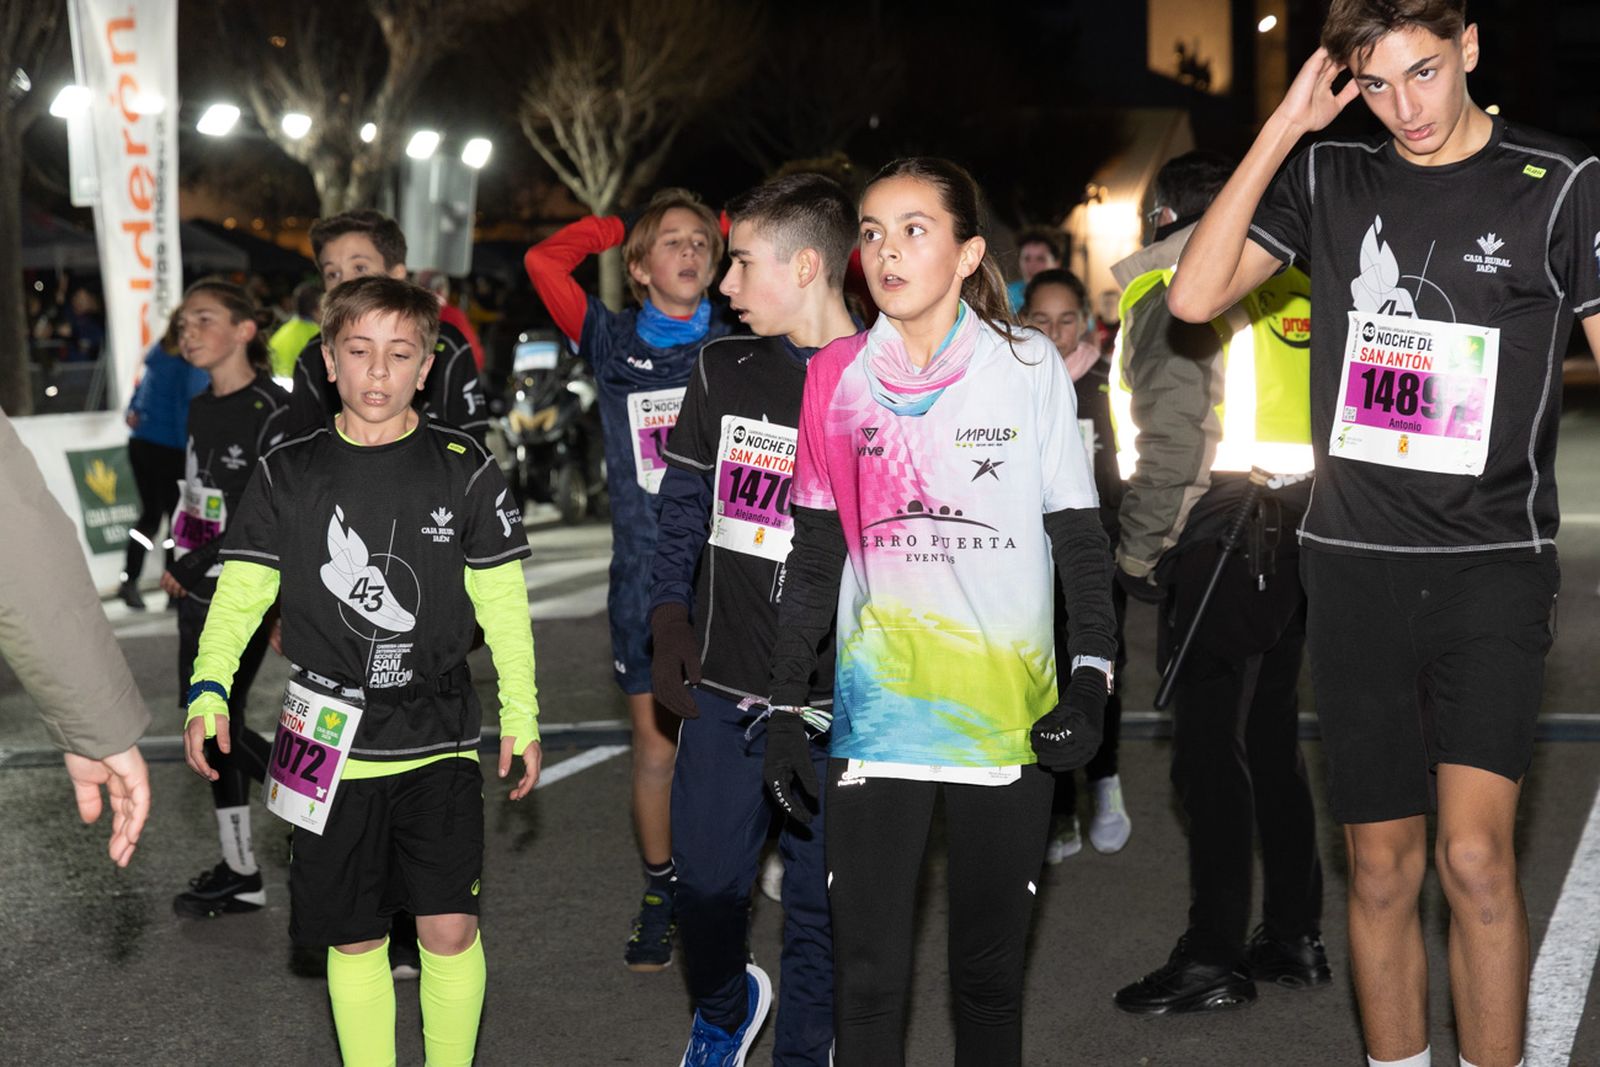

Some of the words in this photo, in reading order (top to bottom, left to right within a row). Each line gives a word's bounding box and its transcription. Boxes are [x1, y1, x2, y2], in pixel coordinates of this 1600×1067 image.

[1463, 254, 1483, 263] CAJA
[1485, 256, 1512, 267] RURAL
[1476, 264, 1498, 273] JAÉN
[1376, 331, 1415, 349] NOCHE
[1417, 337, 1433, 351] DE
[1359, 346, 1385, 364] SAN
[1386, 351, 1434, 370] ANTÓN
[1361, 367, 1467, 421] 1489
[654, 402, 679, 412] NOCH
[644, 415, 665, 427] SAN
[1389, 418, 1422, 432] Antonio
[745, 435, 786, 454] NOCHE
[786, 443, 796, 456] D
[729, 447, 754, 464] SAN
[753, 454, 795, 474] ANTÓN
[735, 508, 770, 525] Alejandro
[421, 527, 438, 535] CAJA
[861, 535, 918, 548] ERRO
[931, 535, 1016, 549] PUERTA
[348, 577, 385, 613] 43
[371, 659, 401, 672] SAN
[369, 668, 413, 684] ANTÓN
[296, 702, 310, 718] DE
